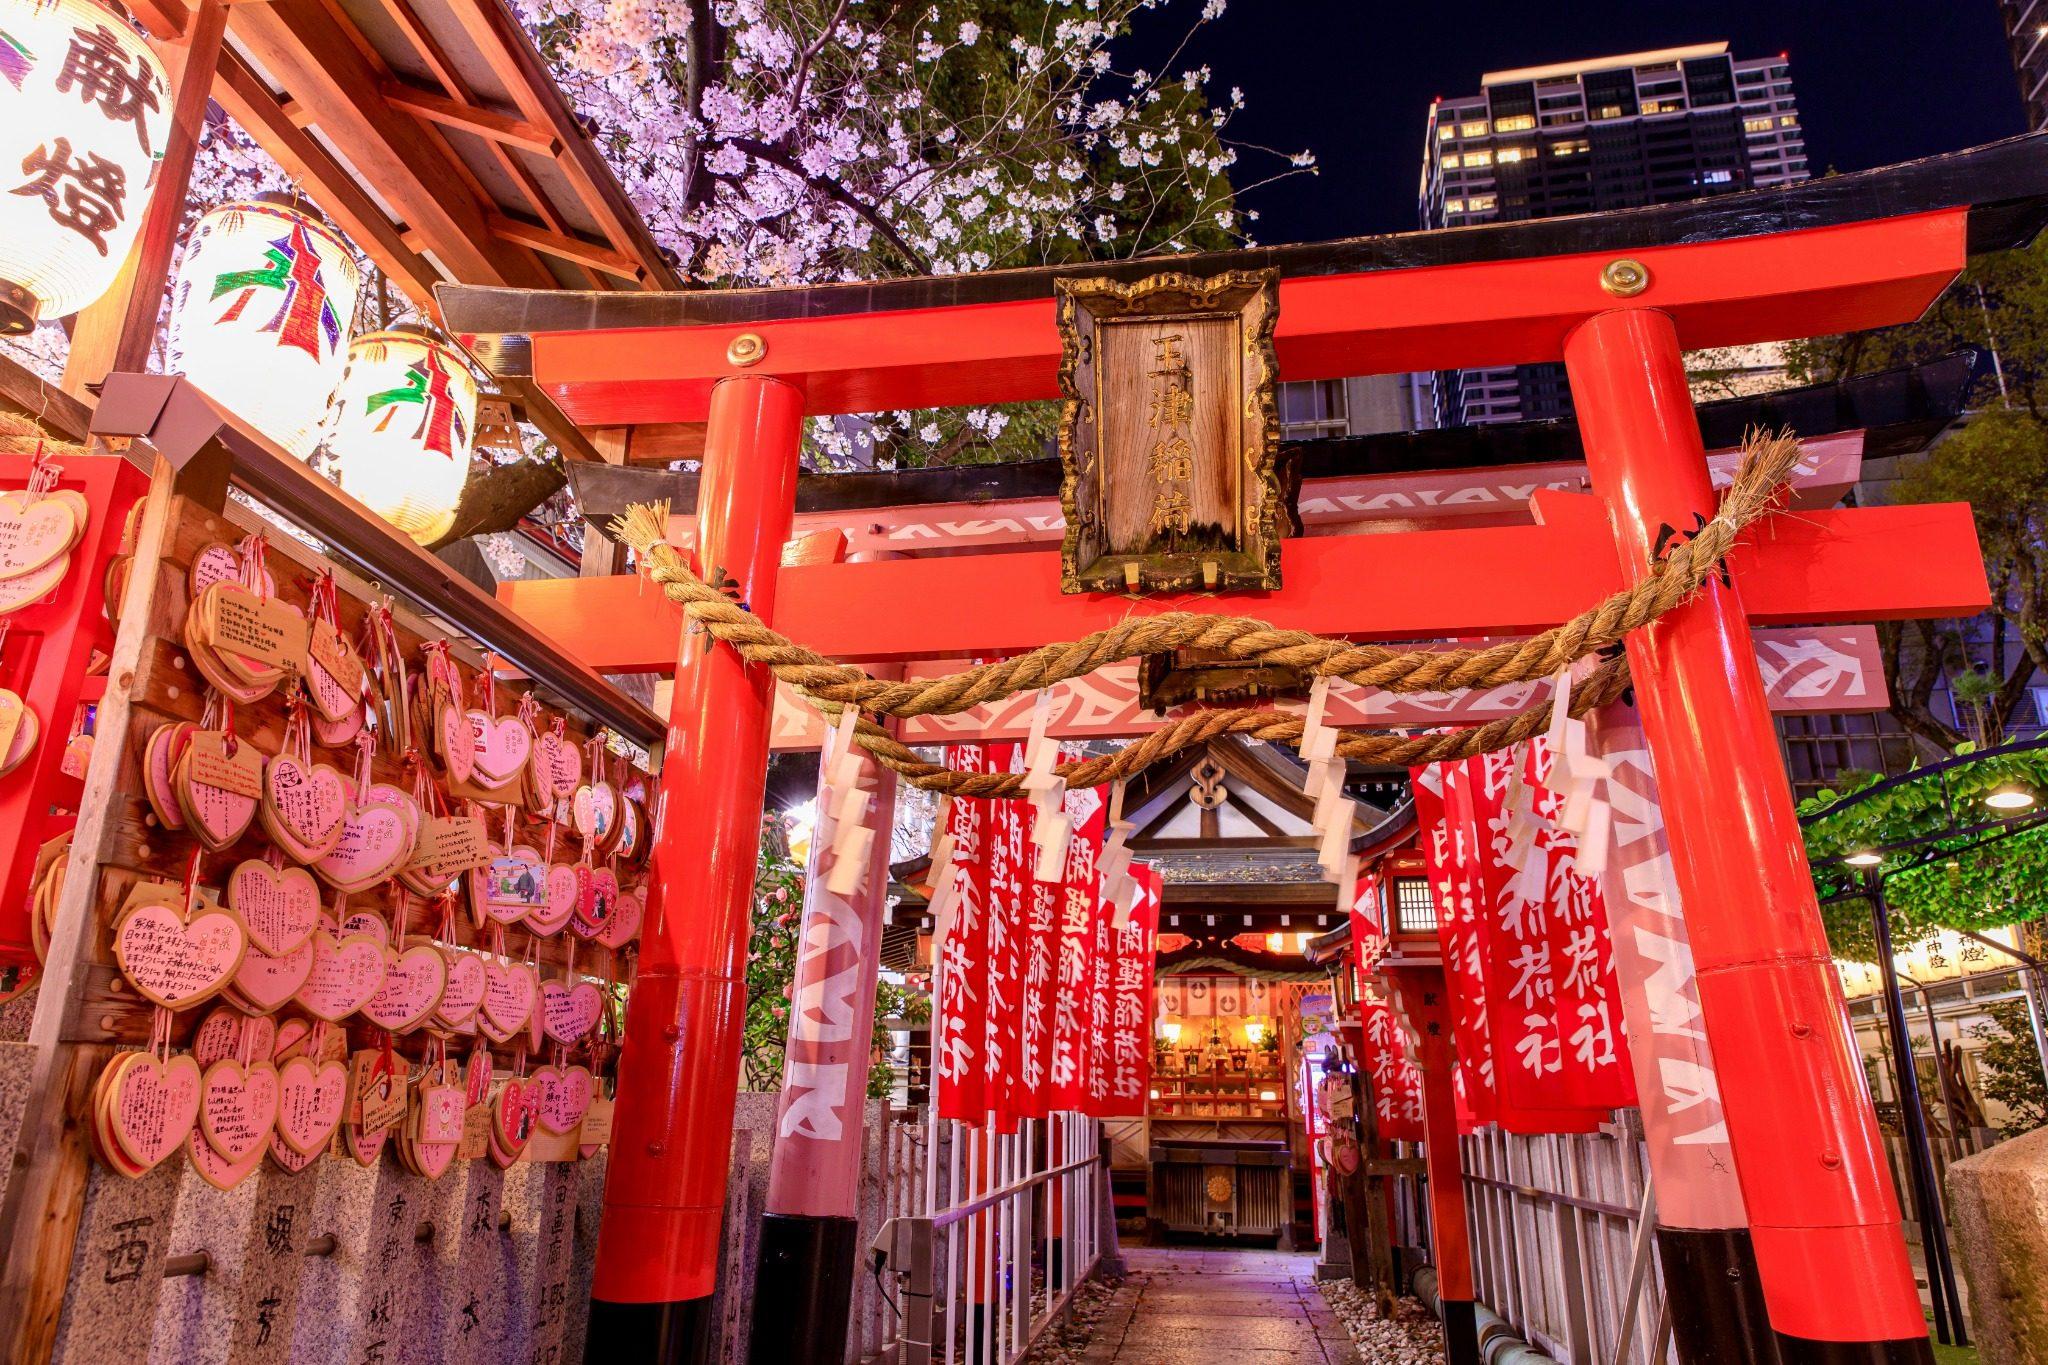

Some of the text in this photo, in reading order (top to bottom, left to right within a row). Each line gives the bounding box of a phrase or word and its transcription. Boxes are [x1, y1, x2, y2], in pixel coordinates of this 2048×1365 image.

[1146, 333, 1194, 537] 玉津稲荷
[104, 1216, 154, 1285] 西
